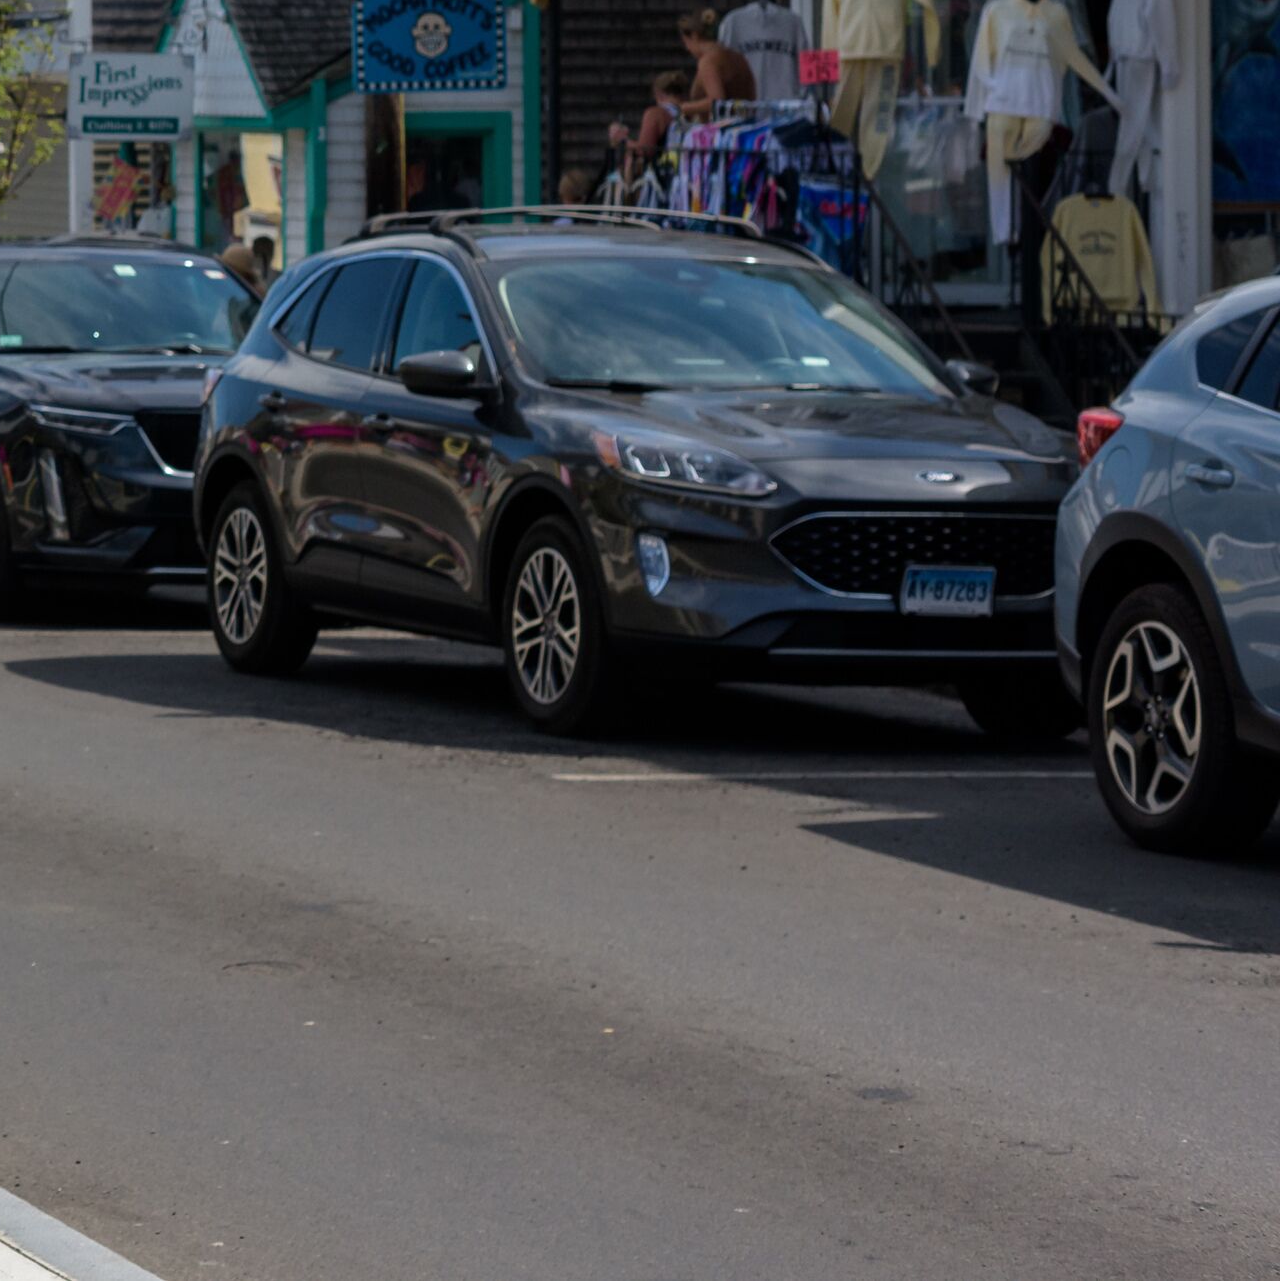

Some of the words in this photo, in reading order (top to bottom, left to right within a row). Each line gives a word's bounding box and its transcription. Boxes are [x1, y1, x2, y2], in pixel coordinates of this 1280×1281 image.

[95, 60, 137, 85] First
[368, 40, 416, 77] GOOD
[424, 41, 492, 79] COFFEE
[79, 75, 183, 108] Impressions
